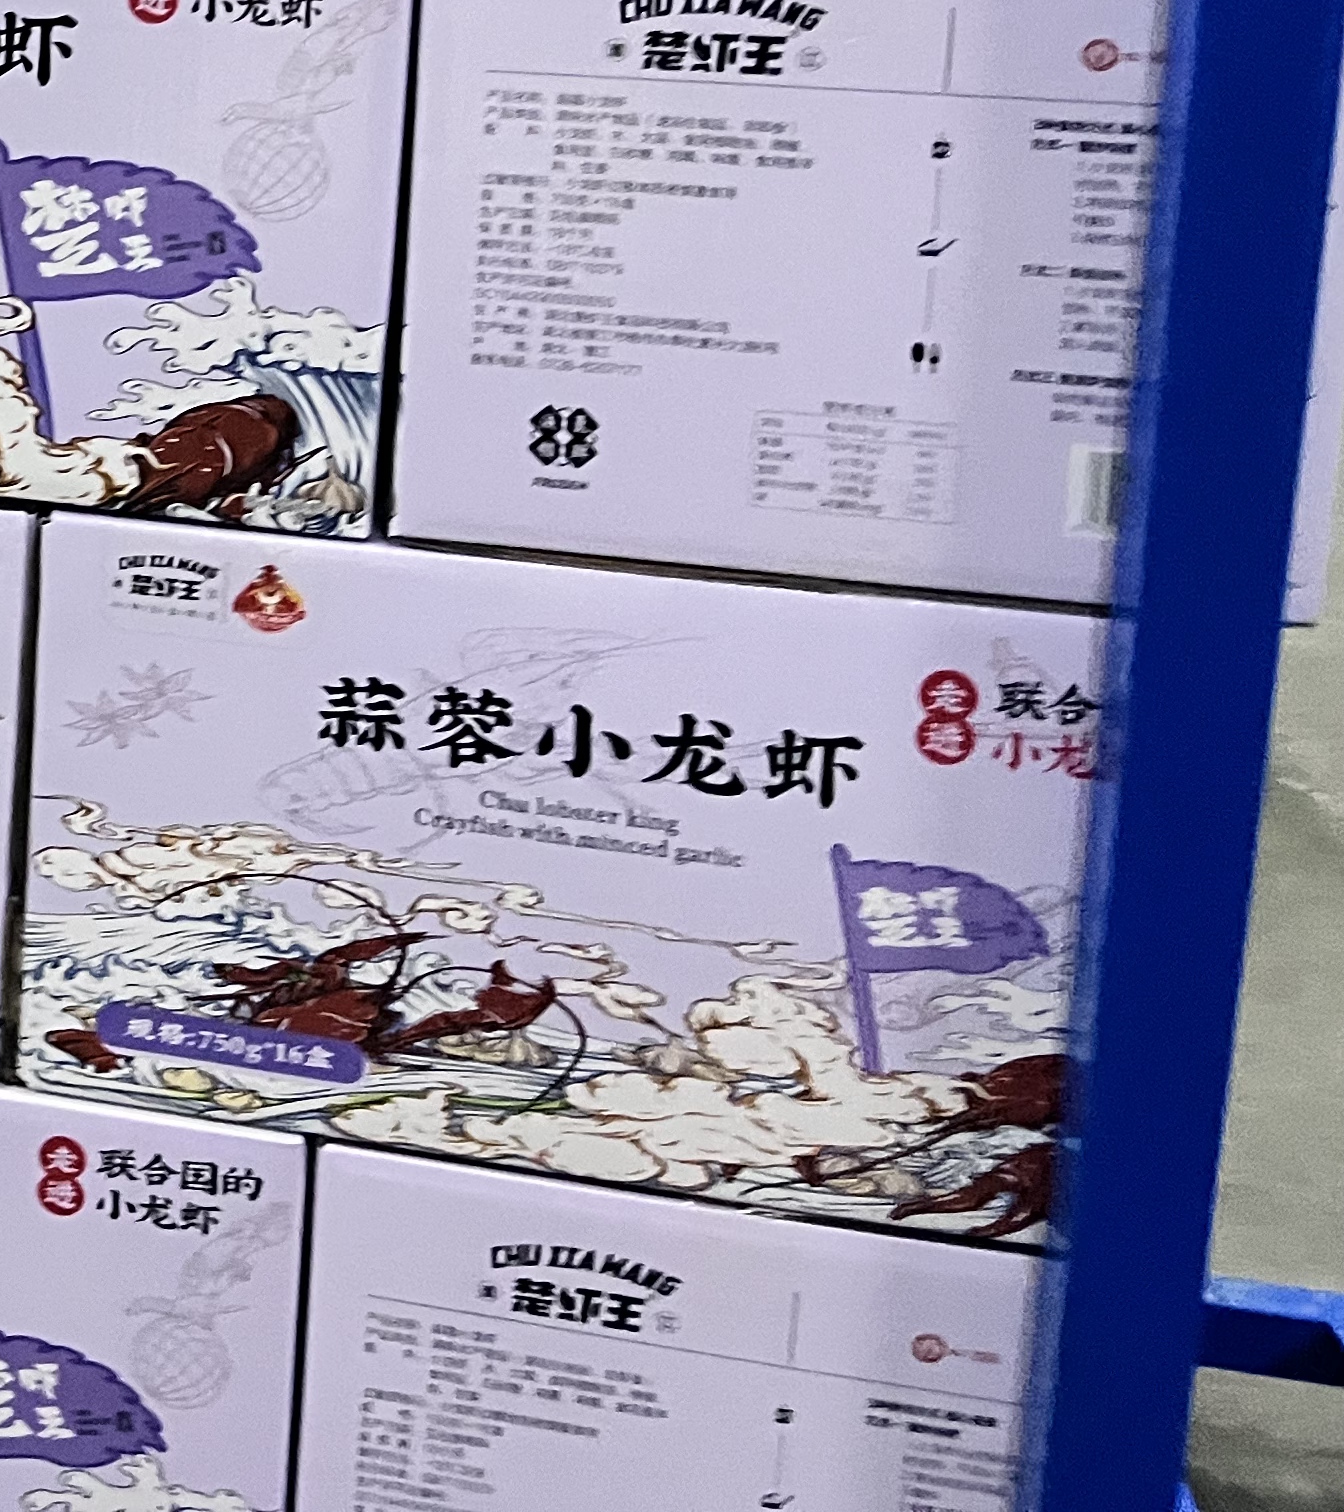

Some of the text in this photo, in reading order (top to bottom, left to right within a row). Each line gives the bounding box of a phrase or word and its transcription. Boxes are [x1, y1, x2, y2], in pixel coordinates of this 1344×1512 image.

[641, 30, 788, 76] 楚虾王
[319, 676, 867, 810] 蒜蓉小龙虾
[96, 1149, 264, 1202] 联合国的
[96, 1190, 221, 1236] 小龙虾
[490, 1244, 685, 1296] CHU XIA WANG
[512, 1277, 645, 1332] 楚虾王
